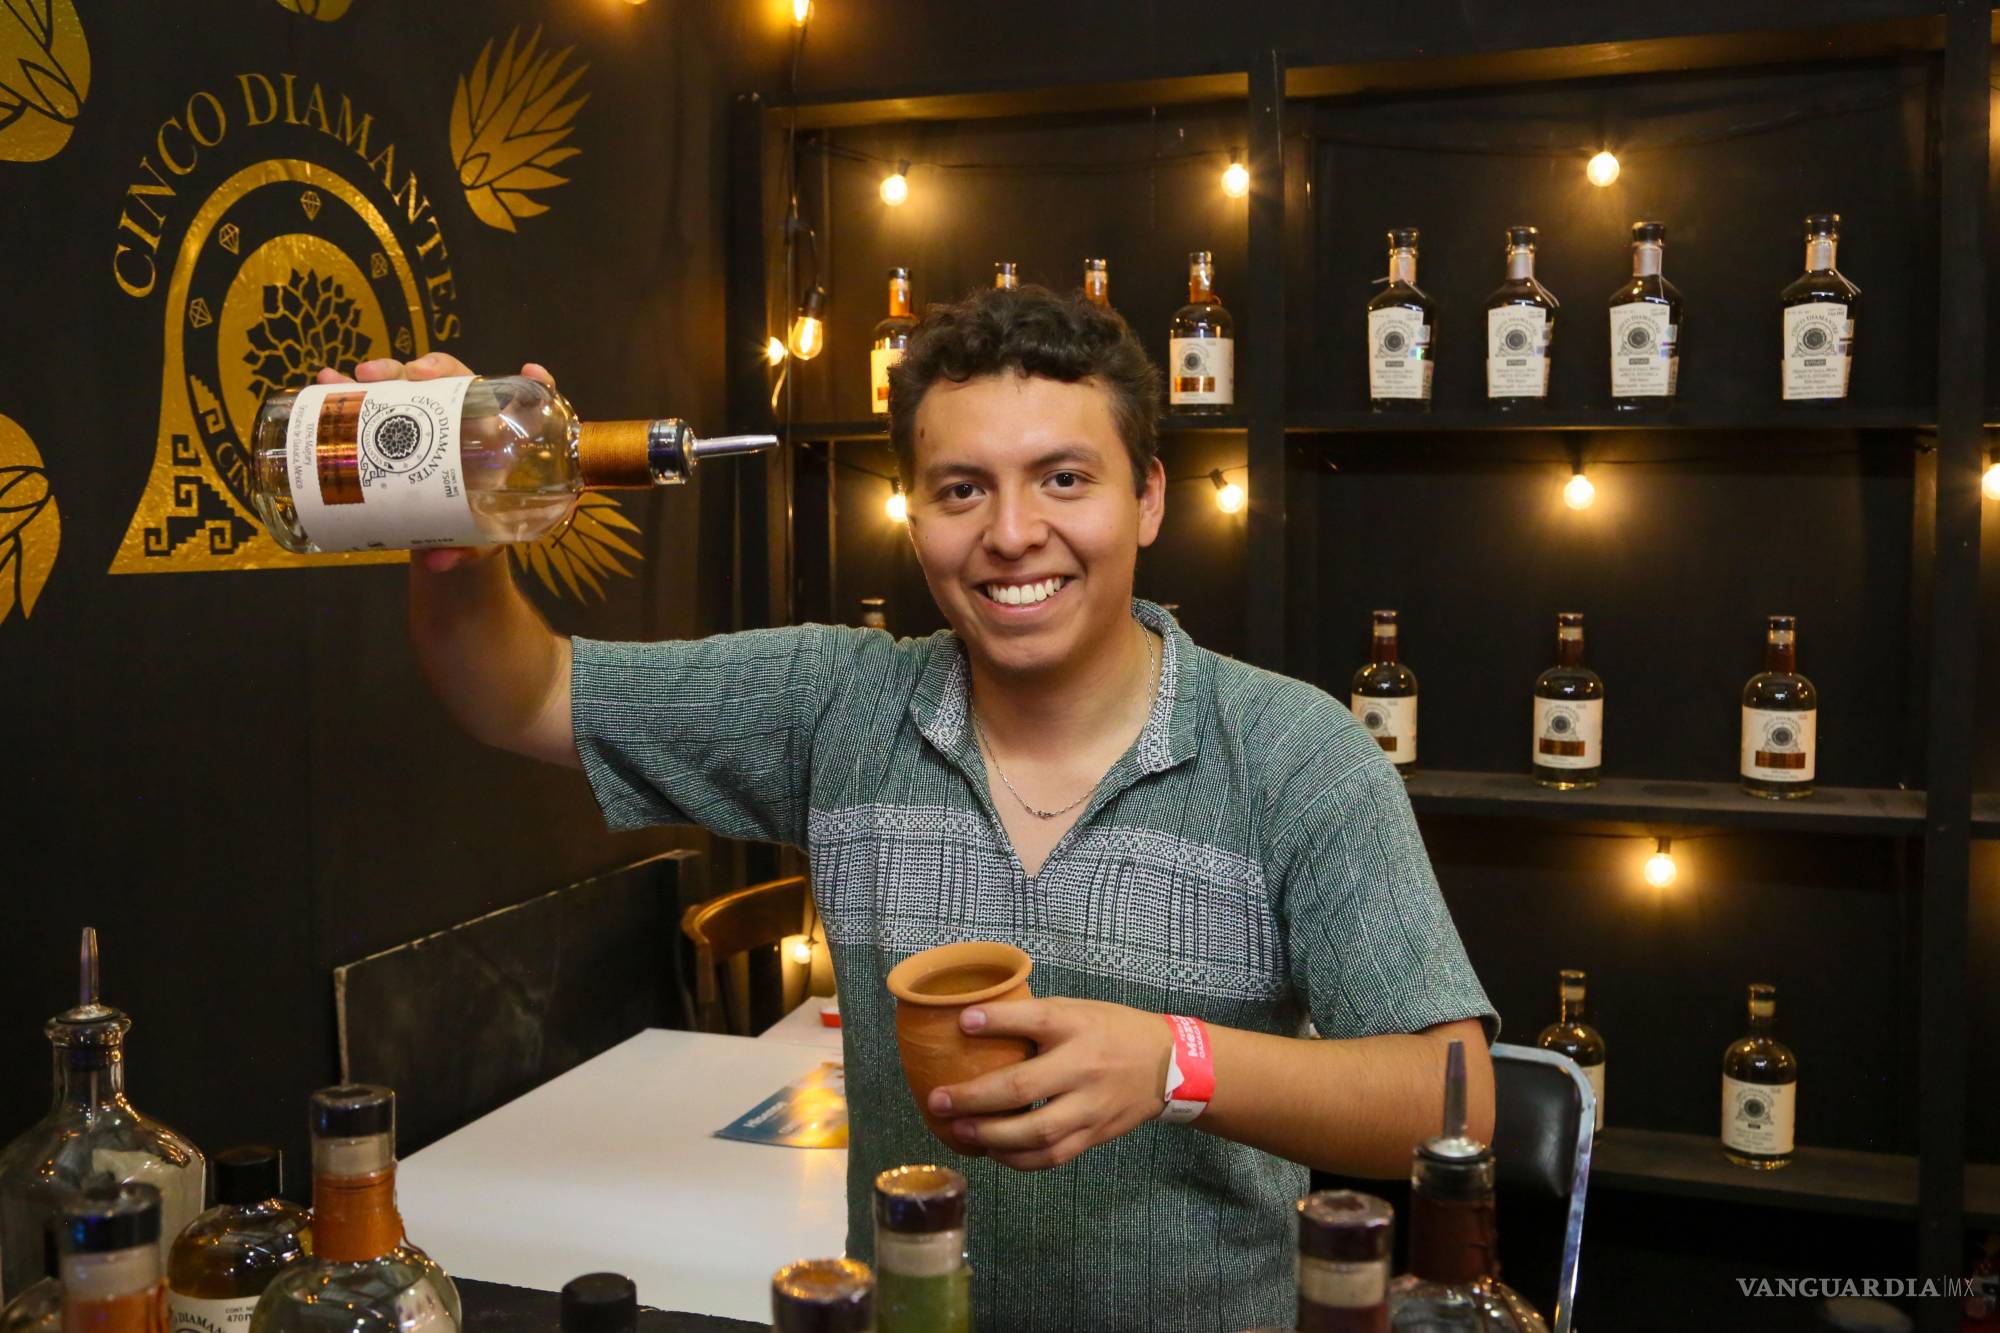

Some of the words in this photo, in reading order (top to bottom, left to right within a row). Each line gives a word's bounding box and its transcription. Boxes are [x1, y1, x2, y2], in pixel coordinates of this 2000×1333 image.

[113, 91, 227, 299] CINCO
[236, 72, 461, 343] DIAMANTES
[411, 394, 445, 417] CINCO
[408, 416, 450, 485] DIAMANTES
